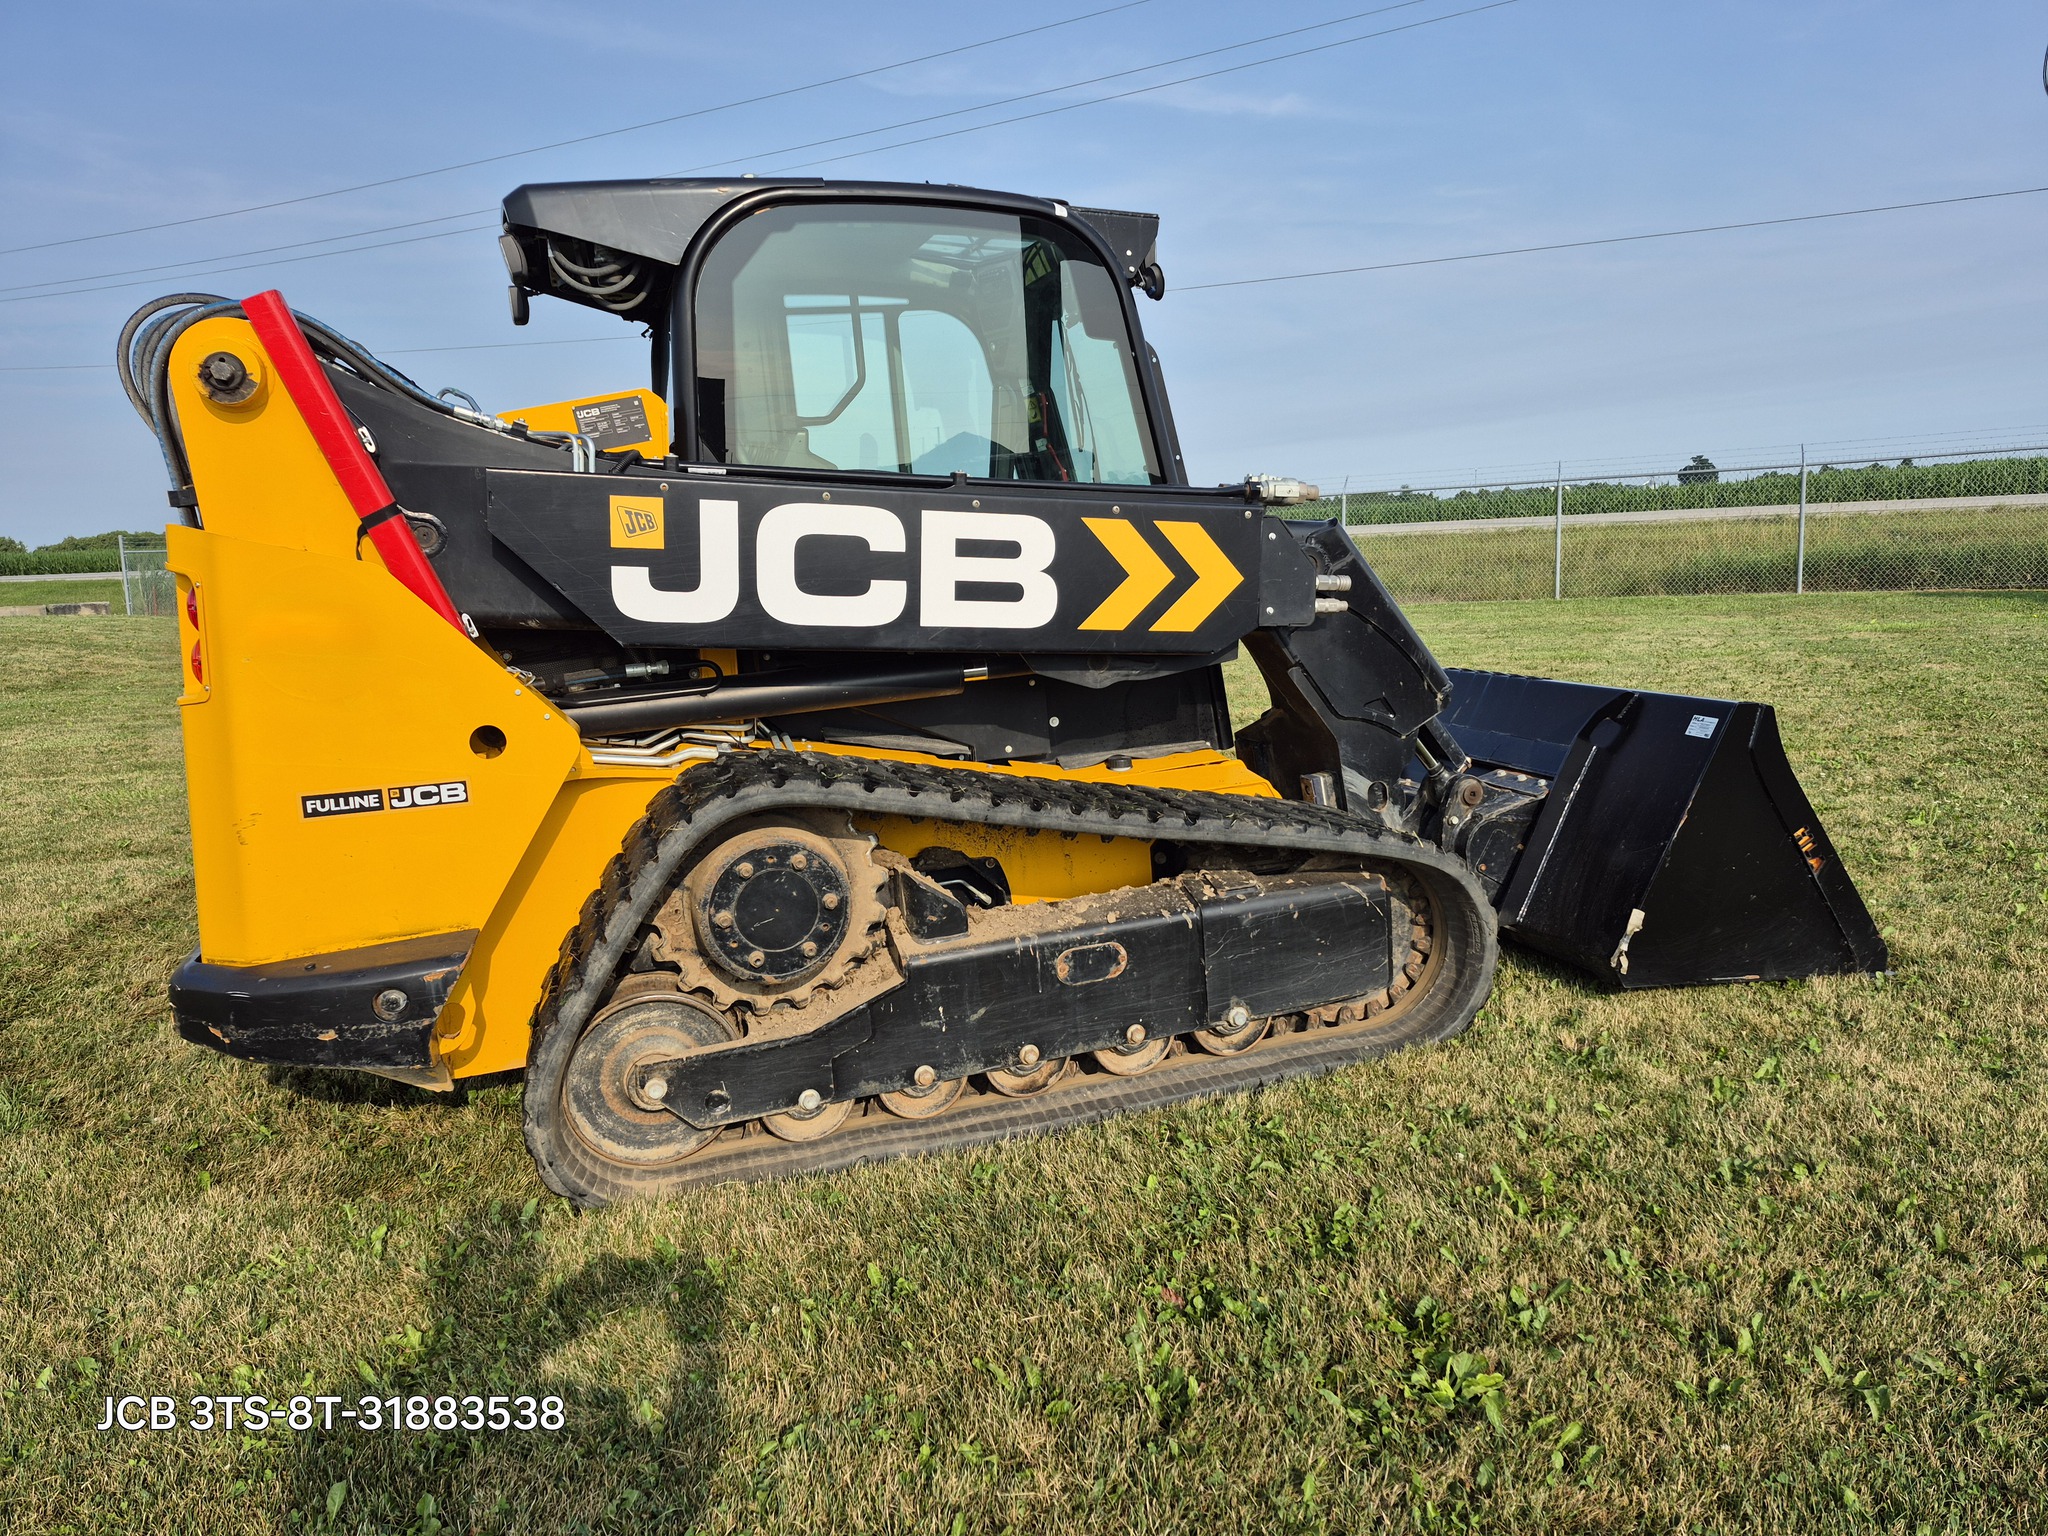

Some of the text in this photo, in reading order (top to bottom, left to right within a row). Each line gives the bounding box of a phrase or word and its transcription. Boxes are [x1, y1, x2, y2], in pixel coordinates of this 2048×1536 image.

[576, 408, 600, 418] JCB
[624, 510, 656, 534] JCB
[611, 499, 1058, 629] JCB
[306, 782, 467, 813] FULLINE JCB
